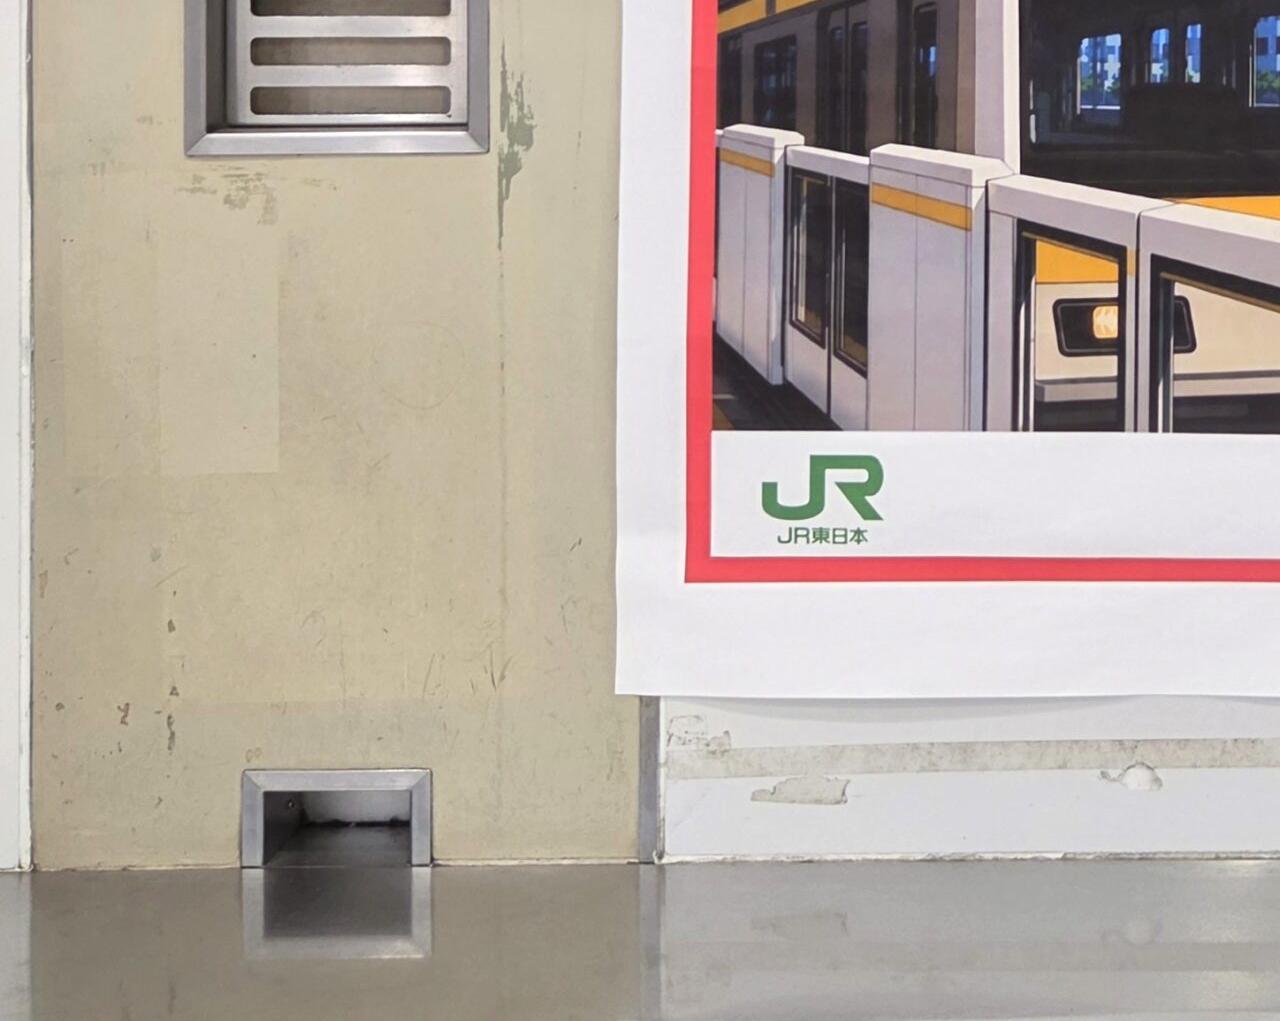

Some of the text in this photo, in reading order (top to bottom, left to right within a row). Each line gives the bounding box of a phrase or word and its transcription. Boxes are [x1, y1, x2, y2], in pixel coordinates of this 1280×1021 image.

[762, 455, 884, 521] JR
[777, 527, 868, 545] JR東日本
